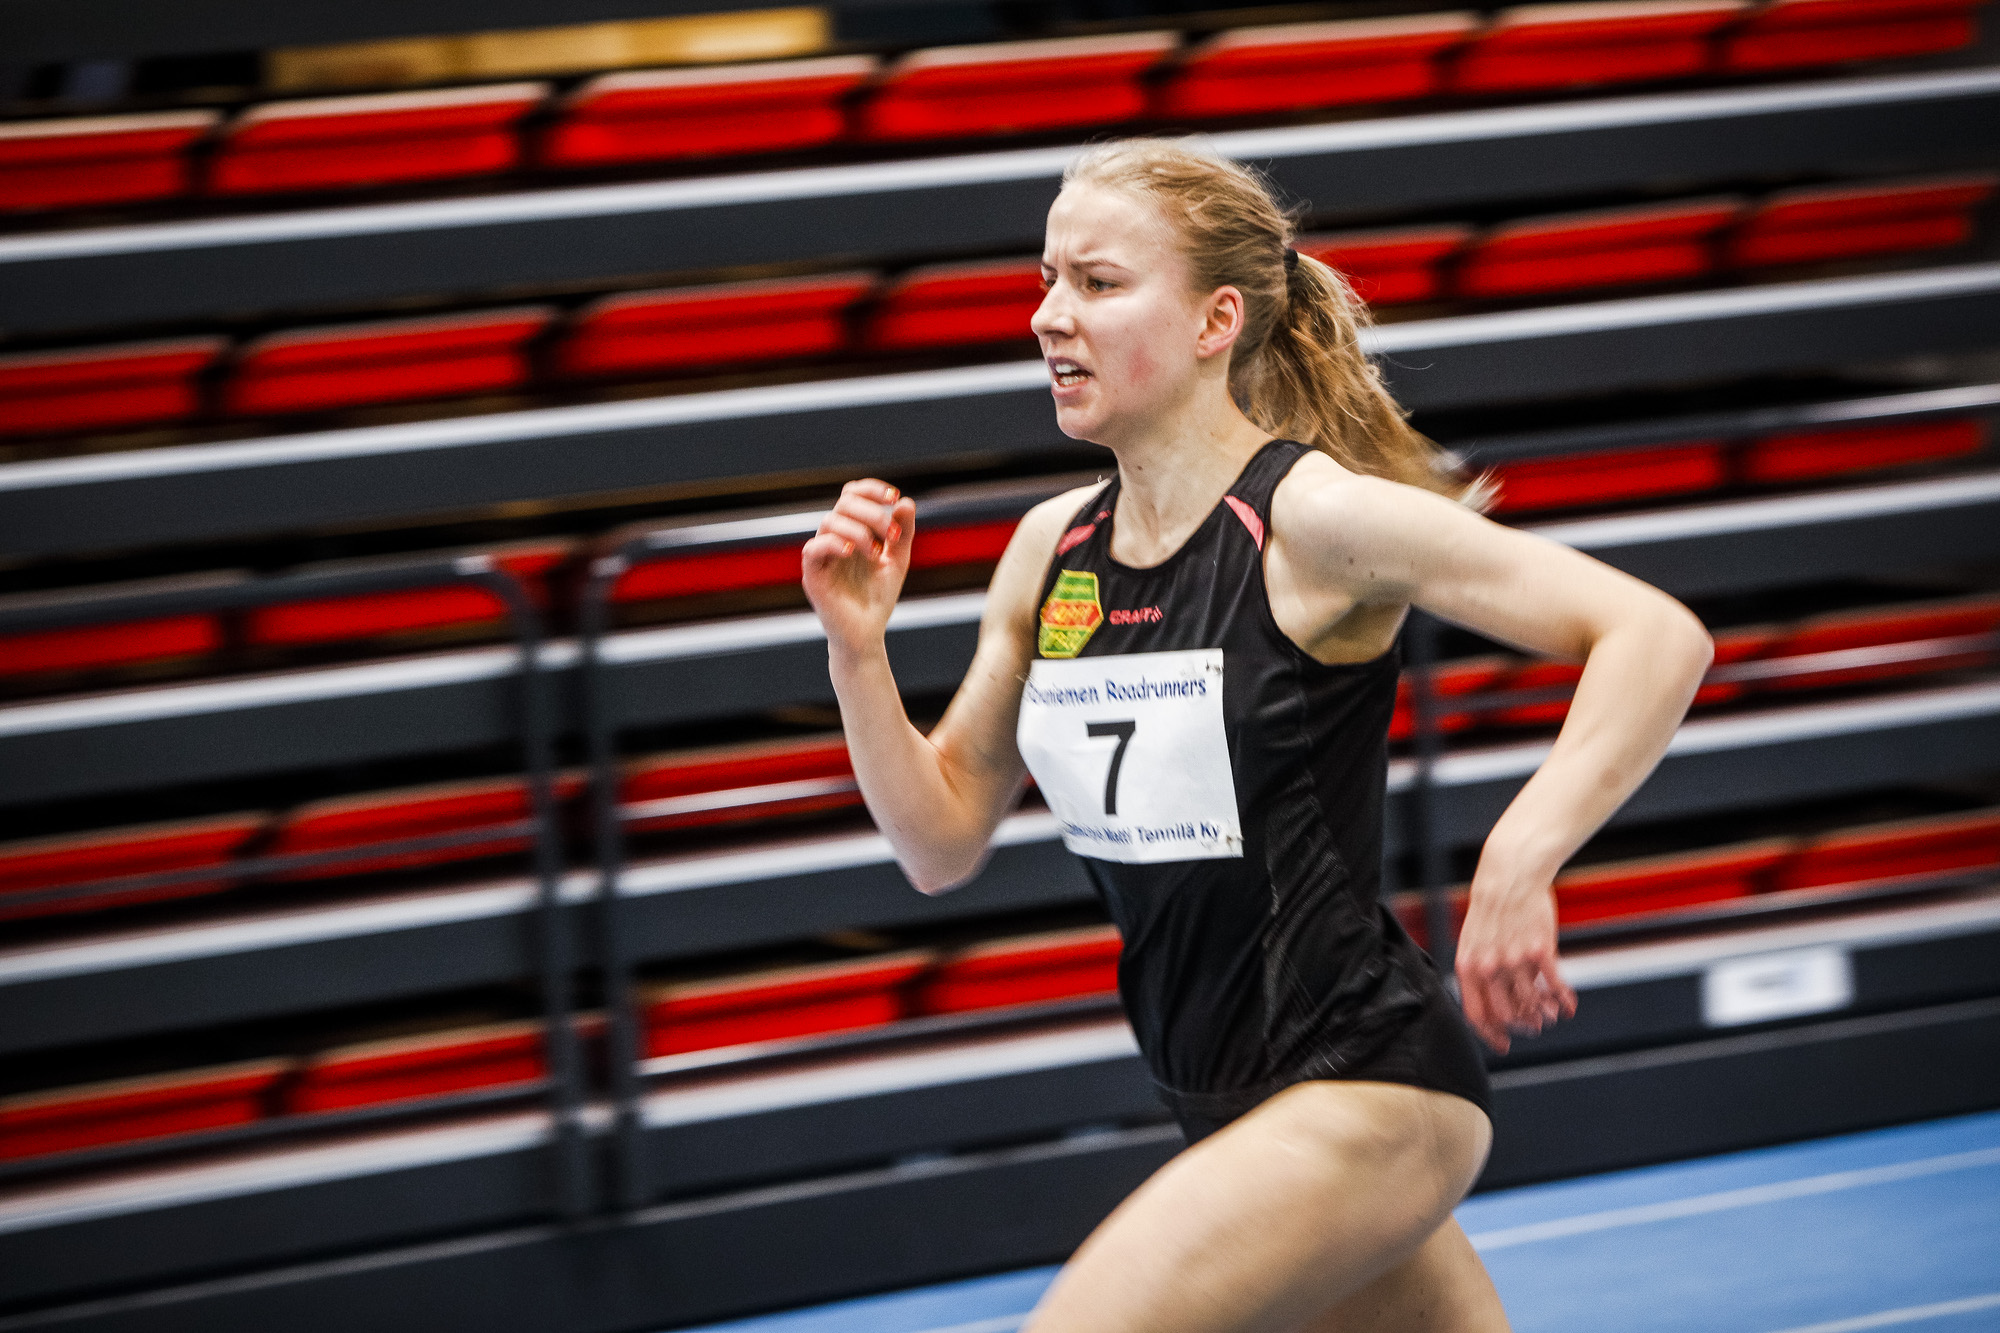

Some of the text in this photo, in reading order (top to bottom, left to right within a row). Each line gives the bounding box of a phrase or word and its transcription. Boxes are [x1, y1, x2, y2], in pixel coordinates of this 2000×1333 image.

[1109, 606, 1154, 626] CRAFT
[1105, 675, 1206, 702] Roadrunners
[1084, 719, 1136, 816] 7
[1136, 822, 1196, 844] Tennilä
[1200, 821, 1219, 843] Ky
